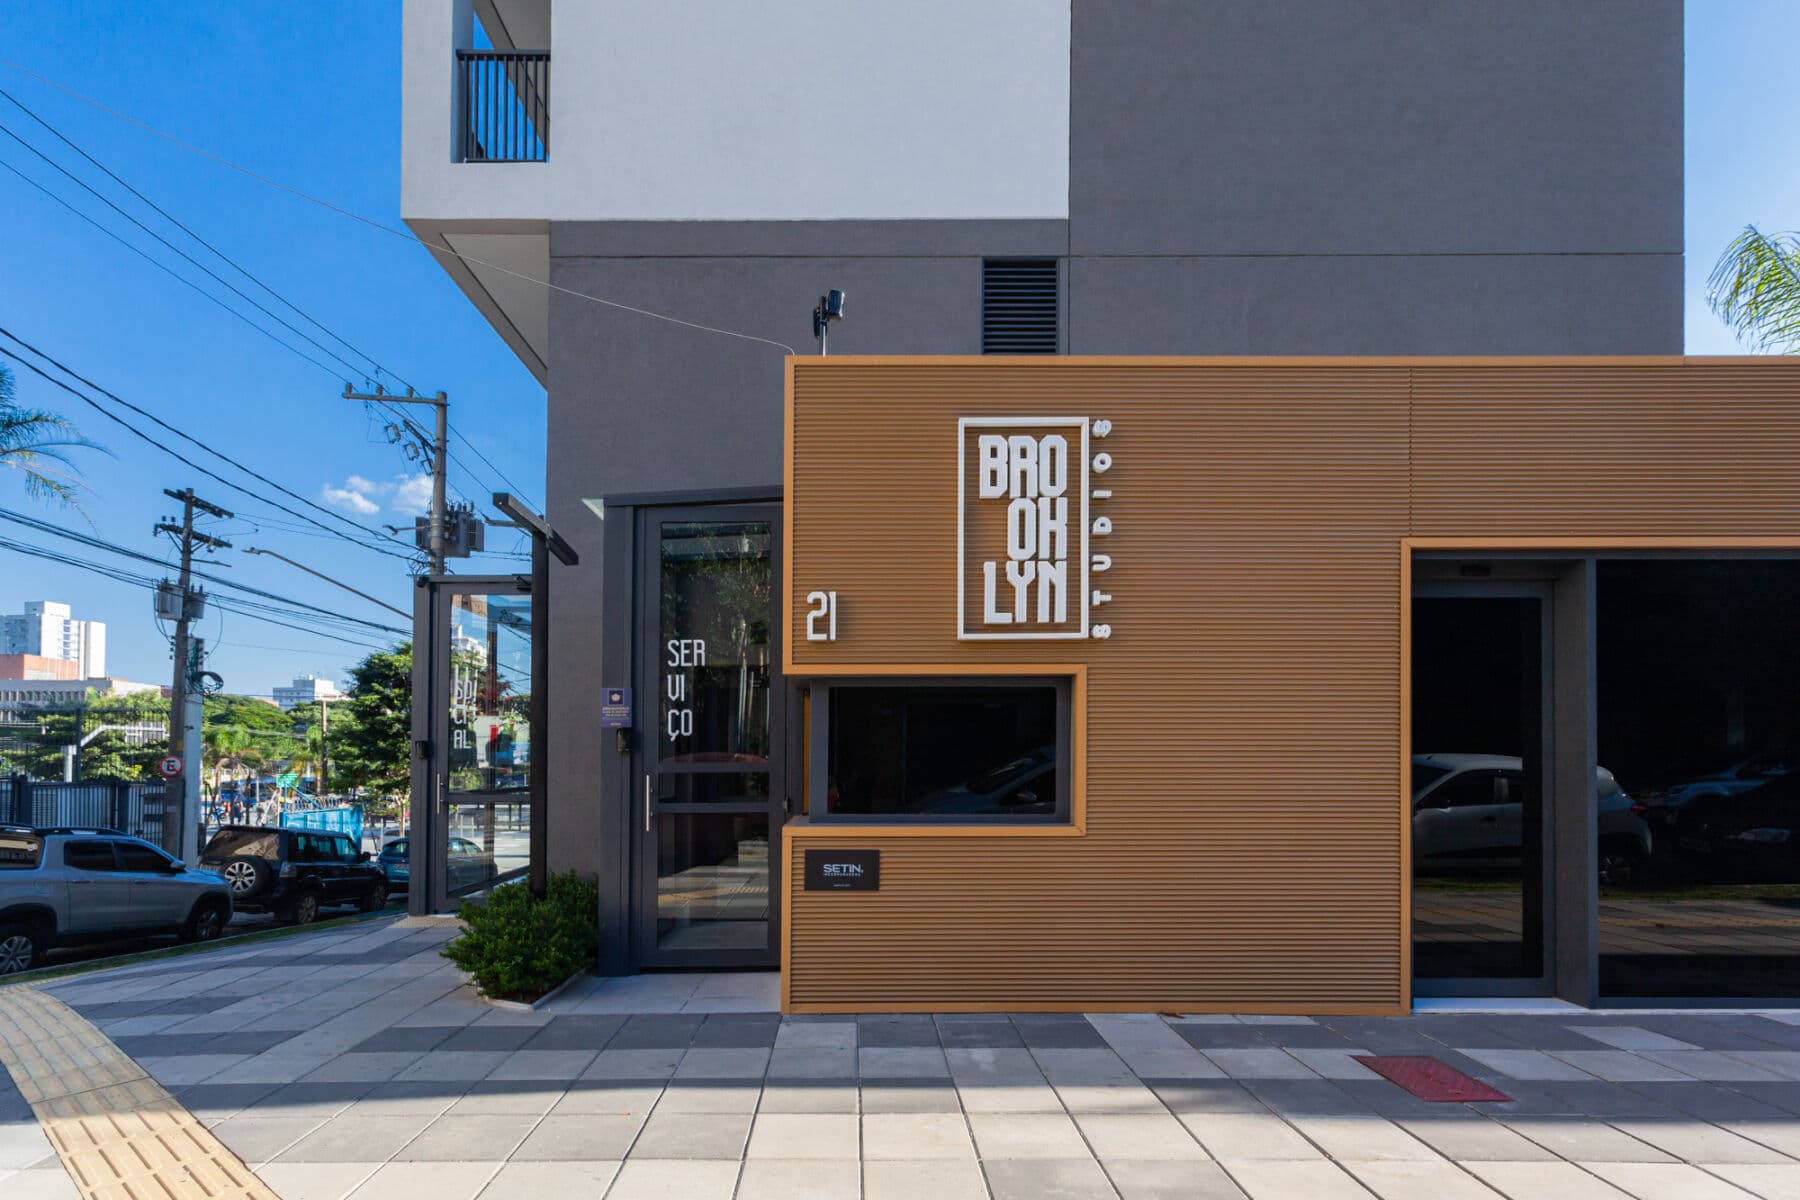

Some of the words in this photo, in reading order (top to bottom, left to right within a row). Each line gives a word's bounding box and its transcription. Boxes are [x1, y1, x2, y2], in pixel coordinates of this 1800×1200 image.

[979, 435, 1068, 499] BRO
[1092, 420, 1112, 639] STUDIOS
[807, 591, 836, 640] 21
[983, 560, 1067, 624] LYN
[667, 639, 706, 667] SER
[453, 729, 472, 749] AL
[668, 708, 693, 742] ÇO
